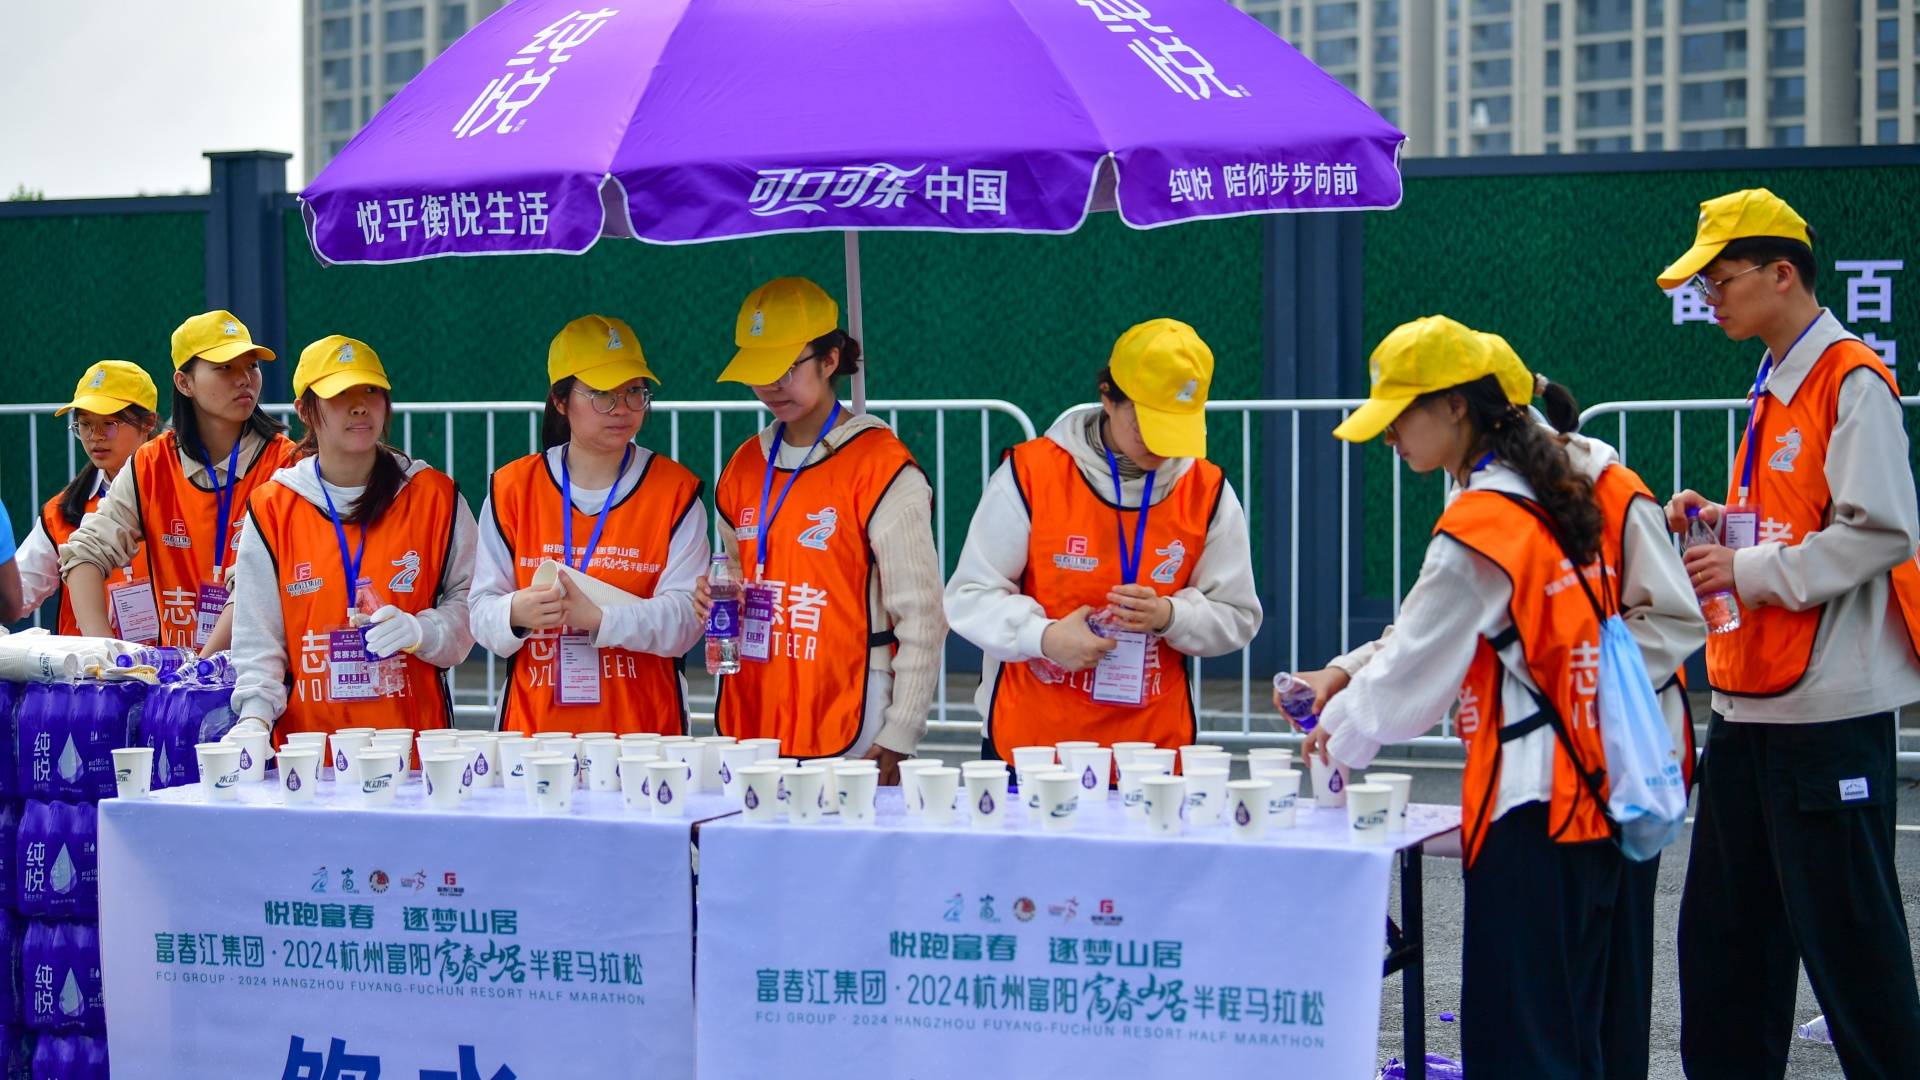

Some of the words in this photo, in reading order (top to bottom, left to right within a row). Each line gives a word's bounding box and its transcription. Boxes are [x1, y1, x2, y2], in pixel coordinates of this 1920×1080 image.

[452, 8, 620, 139] 纯悦
[1168, 166, 1215, 203] 纯悦
[1223, 162, 1359, 199] 陪你步步向前
[356, 190, 549, 246] 悦平衡悦生活
[33, 731, 51, 782] 纯悦
[25, 841, 47, 892] 纯悦
[264, 900, 375, 930] 悦跑富春
[402, 906, 518, 935] 逐梦山居
[889, 930, 1017, 962] 悦跑富春
[1049, 936, 1183, 968] 逐梦山居
[35, 963, 54, 1014] 纯悦
[156, 971, 177, 982] FCJ
[182, 972, 225, 984] GROUP
[238, 975, 267, 986] 2024
[272, 976, 345, 991] HANGZHOU
[351, 980, 464, 997] FUYANG-FUCHUN
[471, 987, 523, 999] RESORT
[529, 989, 564, 1001] HALF
[570, 991, 645, 1005] MARATHON
[755, 1011, 780, 1024] FCJ
[787, 1011, 837, 1025] GROUP
[853, 1013, 888, 1026] 2024
[895, 1016, 976, 1031] HANGZHOU
[983, 1018, 1115, 1037] FUYANG-FUCHUN
[1123, 1026, 1183, 1040] RESORT
[1189, 1029, 1228, 1043] HALF
[1234, 1032, 1325, 1050] MARATHON
